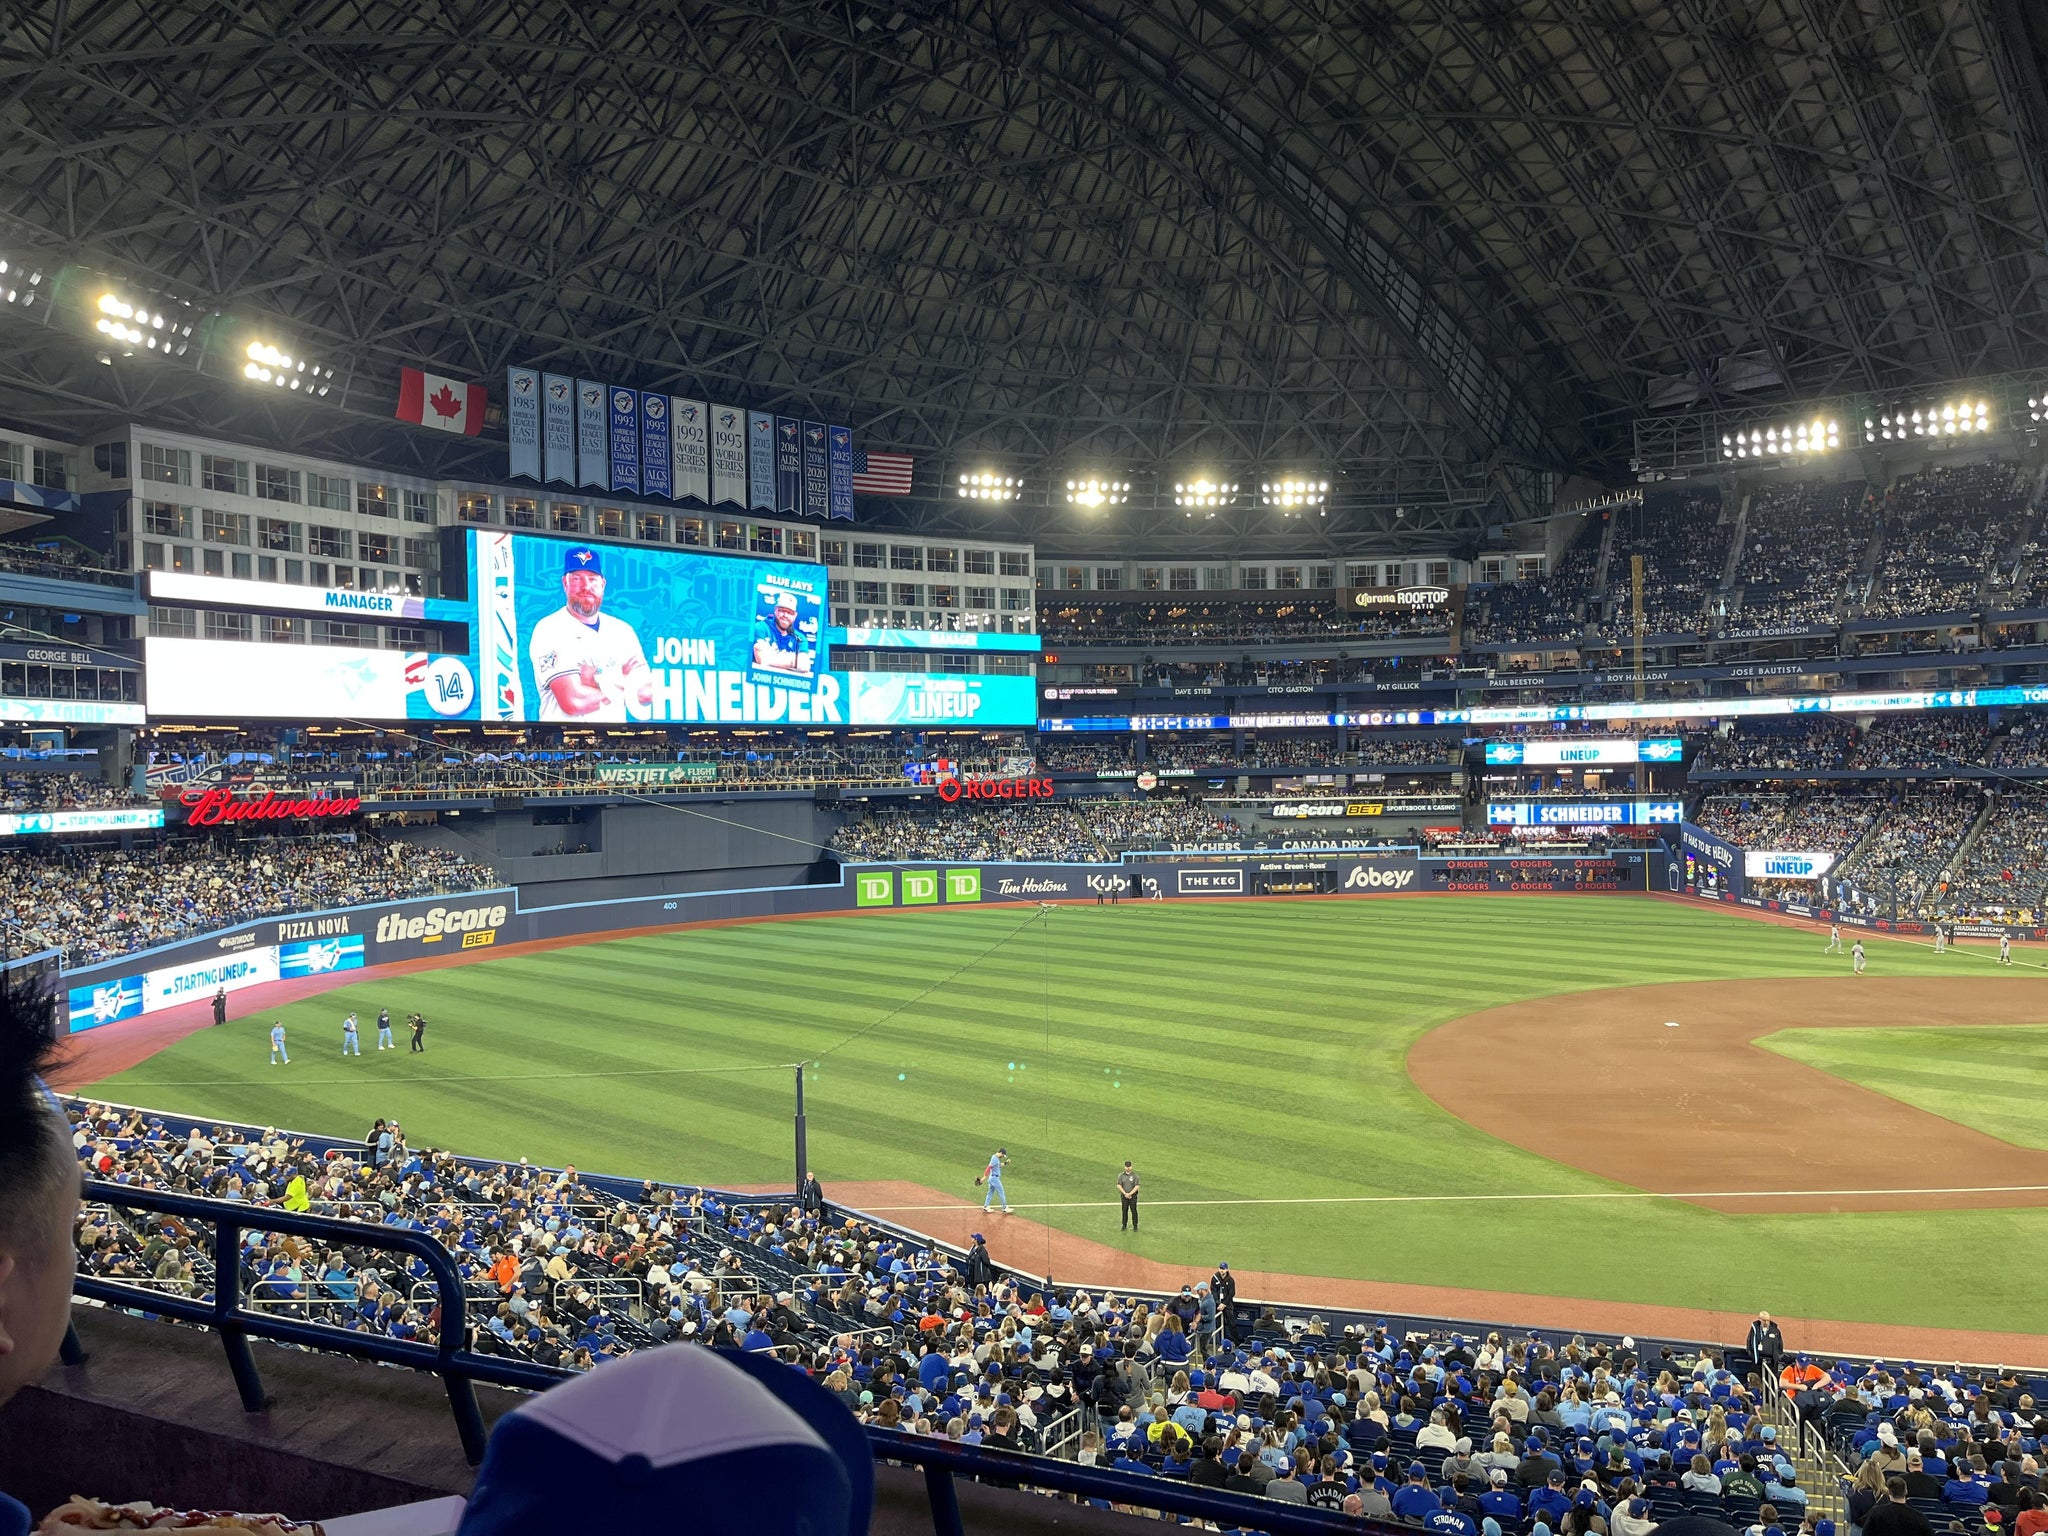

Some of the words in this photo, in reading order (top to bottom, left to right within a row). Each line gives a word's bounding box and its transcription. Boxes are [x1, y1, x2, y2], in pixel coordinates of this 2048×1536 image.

[514, 397, 534, 410] 1985
[549, 403, 569, 416] 1989
[584, 409, 601, 421] 1991
[512, 418, 536, 428] LEAGUE
[614, 414, 634, 427] 1992
[646, 420, 665, 432] 1993
[512, 427, 536, 438] EAST
[548, 424, 570, 434] LEAGUE
[582, 430, 603, 439] LEAGUE
[677, 425, 704, 442] 1992
[512, 436, 536, 446] CHAMPS
[548, 433, 570, 444] EAST
[582, 438, 602, 449] EAST
[614, 434, 636, 444] LEAGUE
[716, 432, 742, 448] 1993
[753, 438, 770, 448] 2015
[548, 442, 570, 452] CHAMPS
[614, 443, 635, 454] EAST
[646, 440, 666, 449] LEAGUE
[676, 443, 705, 456] WORLD
[781, 442, 798, 453] 2016
[582, 448, 604, 456] CHAMPS
[614, 452, 636, 461] CHAMPS
[646, 448, 666, 458] EAST
[716, 449, 743, 462] WORLD
[833, 451, 849, 461] 2025
[646, 457, 666, 466] CHAMPS
[676, 455, 705, 467] SERIES
[780, 455, 799, 465] ALDS
[808, 453, 824, 464] 2016
[615, 465, 636, 476] ALCS
[676, 465, 706, 474] CHAMPIONS
[715, 461, 743, 472] SERIES
[753, 463, 771, 473] EAST
[780, 464, 799, 472] CHAMPS
[647, 470, 667, 481] ALCS
[716, 470, 744, 480] CHAMPIONS
[808, 468, 825, 478] 2020
[833, 469, 850, 477] LEAGUE
[615, 475, 637, 485] CHAMPS
[646, 480, 667, 489] CHAMPS
[833, 477, 850, 485] EAST
[754, 485, 772, 495] ALDS
[808, 481, 825, 492] 2022
[808, 496, 826, 507] 2023
[834, 497, 850, 506] ALCS
[766, 574, 791, 587] BLUE
[792, 579, 813, 592] JAYS
[326, 592, 392, 611] MANAGER
[1355, 593, 1396, 607] Corona
[1397, 592, 1448, 604] ROOFTOP
[1730, 629, 1760, 638] JACKIE
[1762, 626, 1809, 637] ROBINSON
[653, 637, 715, 665] JOHN
[27, 650, 67, 662] GEORGE
[71, 653, 91, 664] BELL
[1731, 667, 1754, 676] JOSÉ
[1759, 666, 1803, 675] BAUTISTA
[752, 672, 772, 684] JOHN
[773, 676, 811, 690] SCHNEIDER
[1510, 678, 1544, 686] BEESTON
[1621, 673, 1668, 682] HALLADAY
[435, 672, 464, 702] 14
[1392, 682, 1419, 690] GILLICK
[622, 668, 843, 722] CHNEIDER
[908, 692, 981, 718] LINEUP
[1883, 697, 1912, 705] LINEUP
[1230, 717, 1256, 727] FOLLOW
[1296, 716, 1306, 726] ON
[1307, 715, 1329, 726] SOCIAL
[1561, 750, 1599, 761] LINEUP
[599, 768, 668, 783] WESTJET
[688, 767, 716, 775] FLIGHT
[967, 778, 1054, 798] ROGERS
[180, 788, 361, 826] Budweiser
[1273, 804, 1343, 818] theScore
[1348, 805, 1381, 815] BET
[110, 814, 137, 825] LINEUP
[1540, 807, 1622, 822] SCHNEIDER
[1572, 826, 1607, 835] LANDING
[1282, 840, 1338, 850] CANADA
[1342, 840, 1369, 848] DRY
[1683, 832, 1688, 843] IT
[1688, 835, 1697, 848] HAS
[1697, 840, 1705, 852] TO
[1705, 844, 1711, 856] BE
[1713, 846, 1733, 868] HEINZ
[1520, 860, 1552, 868] ROGERS
[1766, 862, 1812, 875] LINEUP
[1186, 878, 1210, 886] THE
[1212, 877, 1235, 886] KEG
[1344, 866, 1414, 890] Sobeys
[860, 878, 889, 899] TD
[906, 877, 934, 898] TD
[950, 875, 978, 896] TD
[998, 879, 1020, 894] Tim
[1022, 877, 1068, 893] Hortons
[278, 921, 314, 942] PIZZA
[318, 917, 349, 936] NOVA
[376, 905, 506, 943] theScore
[465, 932, 492, 945] BET
[174, 971, 217, 994] STARTING
[219, 963, 247, 983] LINEUP
[1310, 1488, 1346, 1503] HALLADAY
[1433, 1515, 1465, 1530] STROMAN
